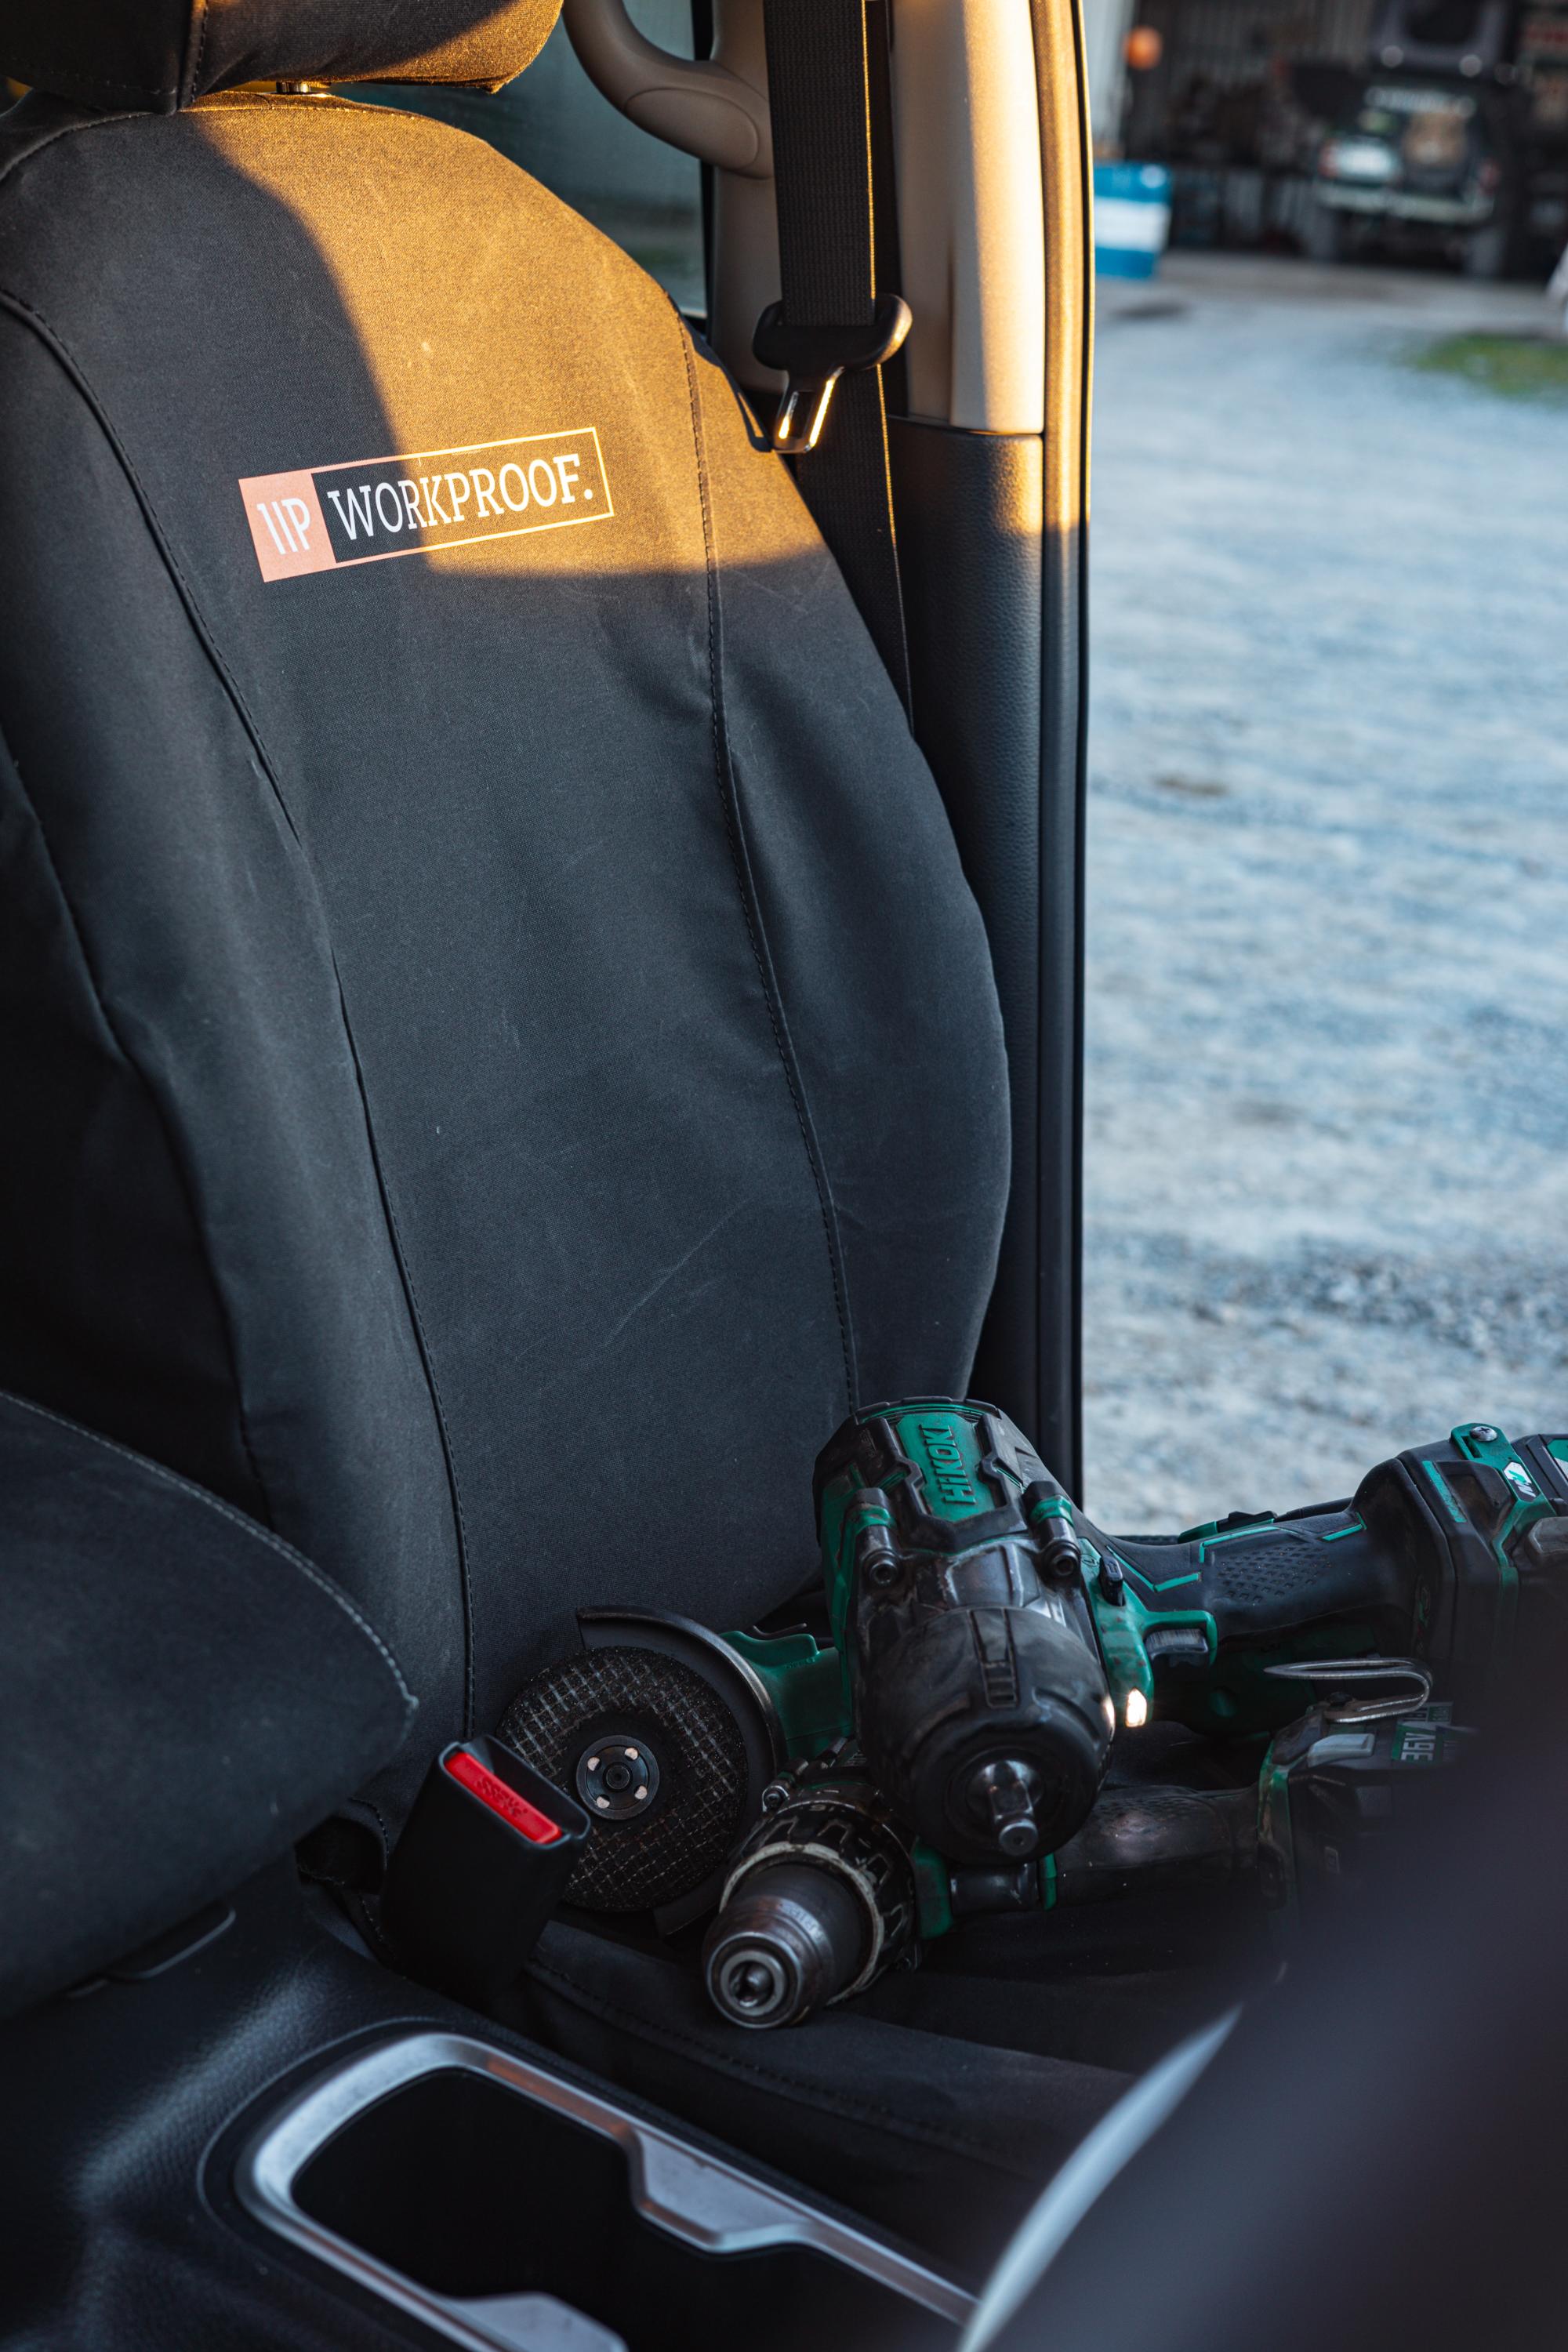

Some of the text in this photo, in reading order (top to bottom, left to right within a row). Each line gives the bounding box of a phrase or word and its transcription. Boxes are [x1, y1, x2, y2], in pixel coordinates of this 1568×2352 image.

[327, 453, 593, 541] WORKPROOF.
[1400, 1732, 1436, 1761] 36V
[474, 1777, 528, 1817] PRESS
